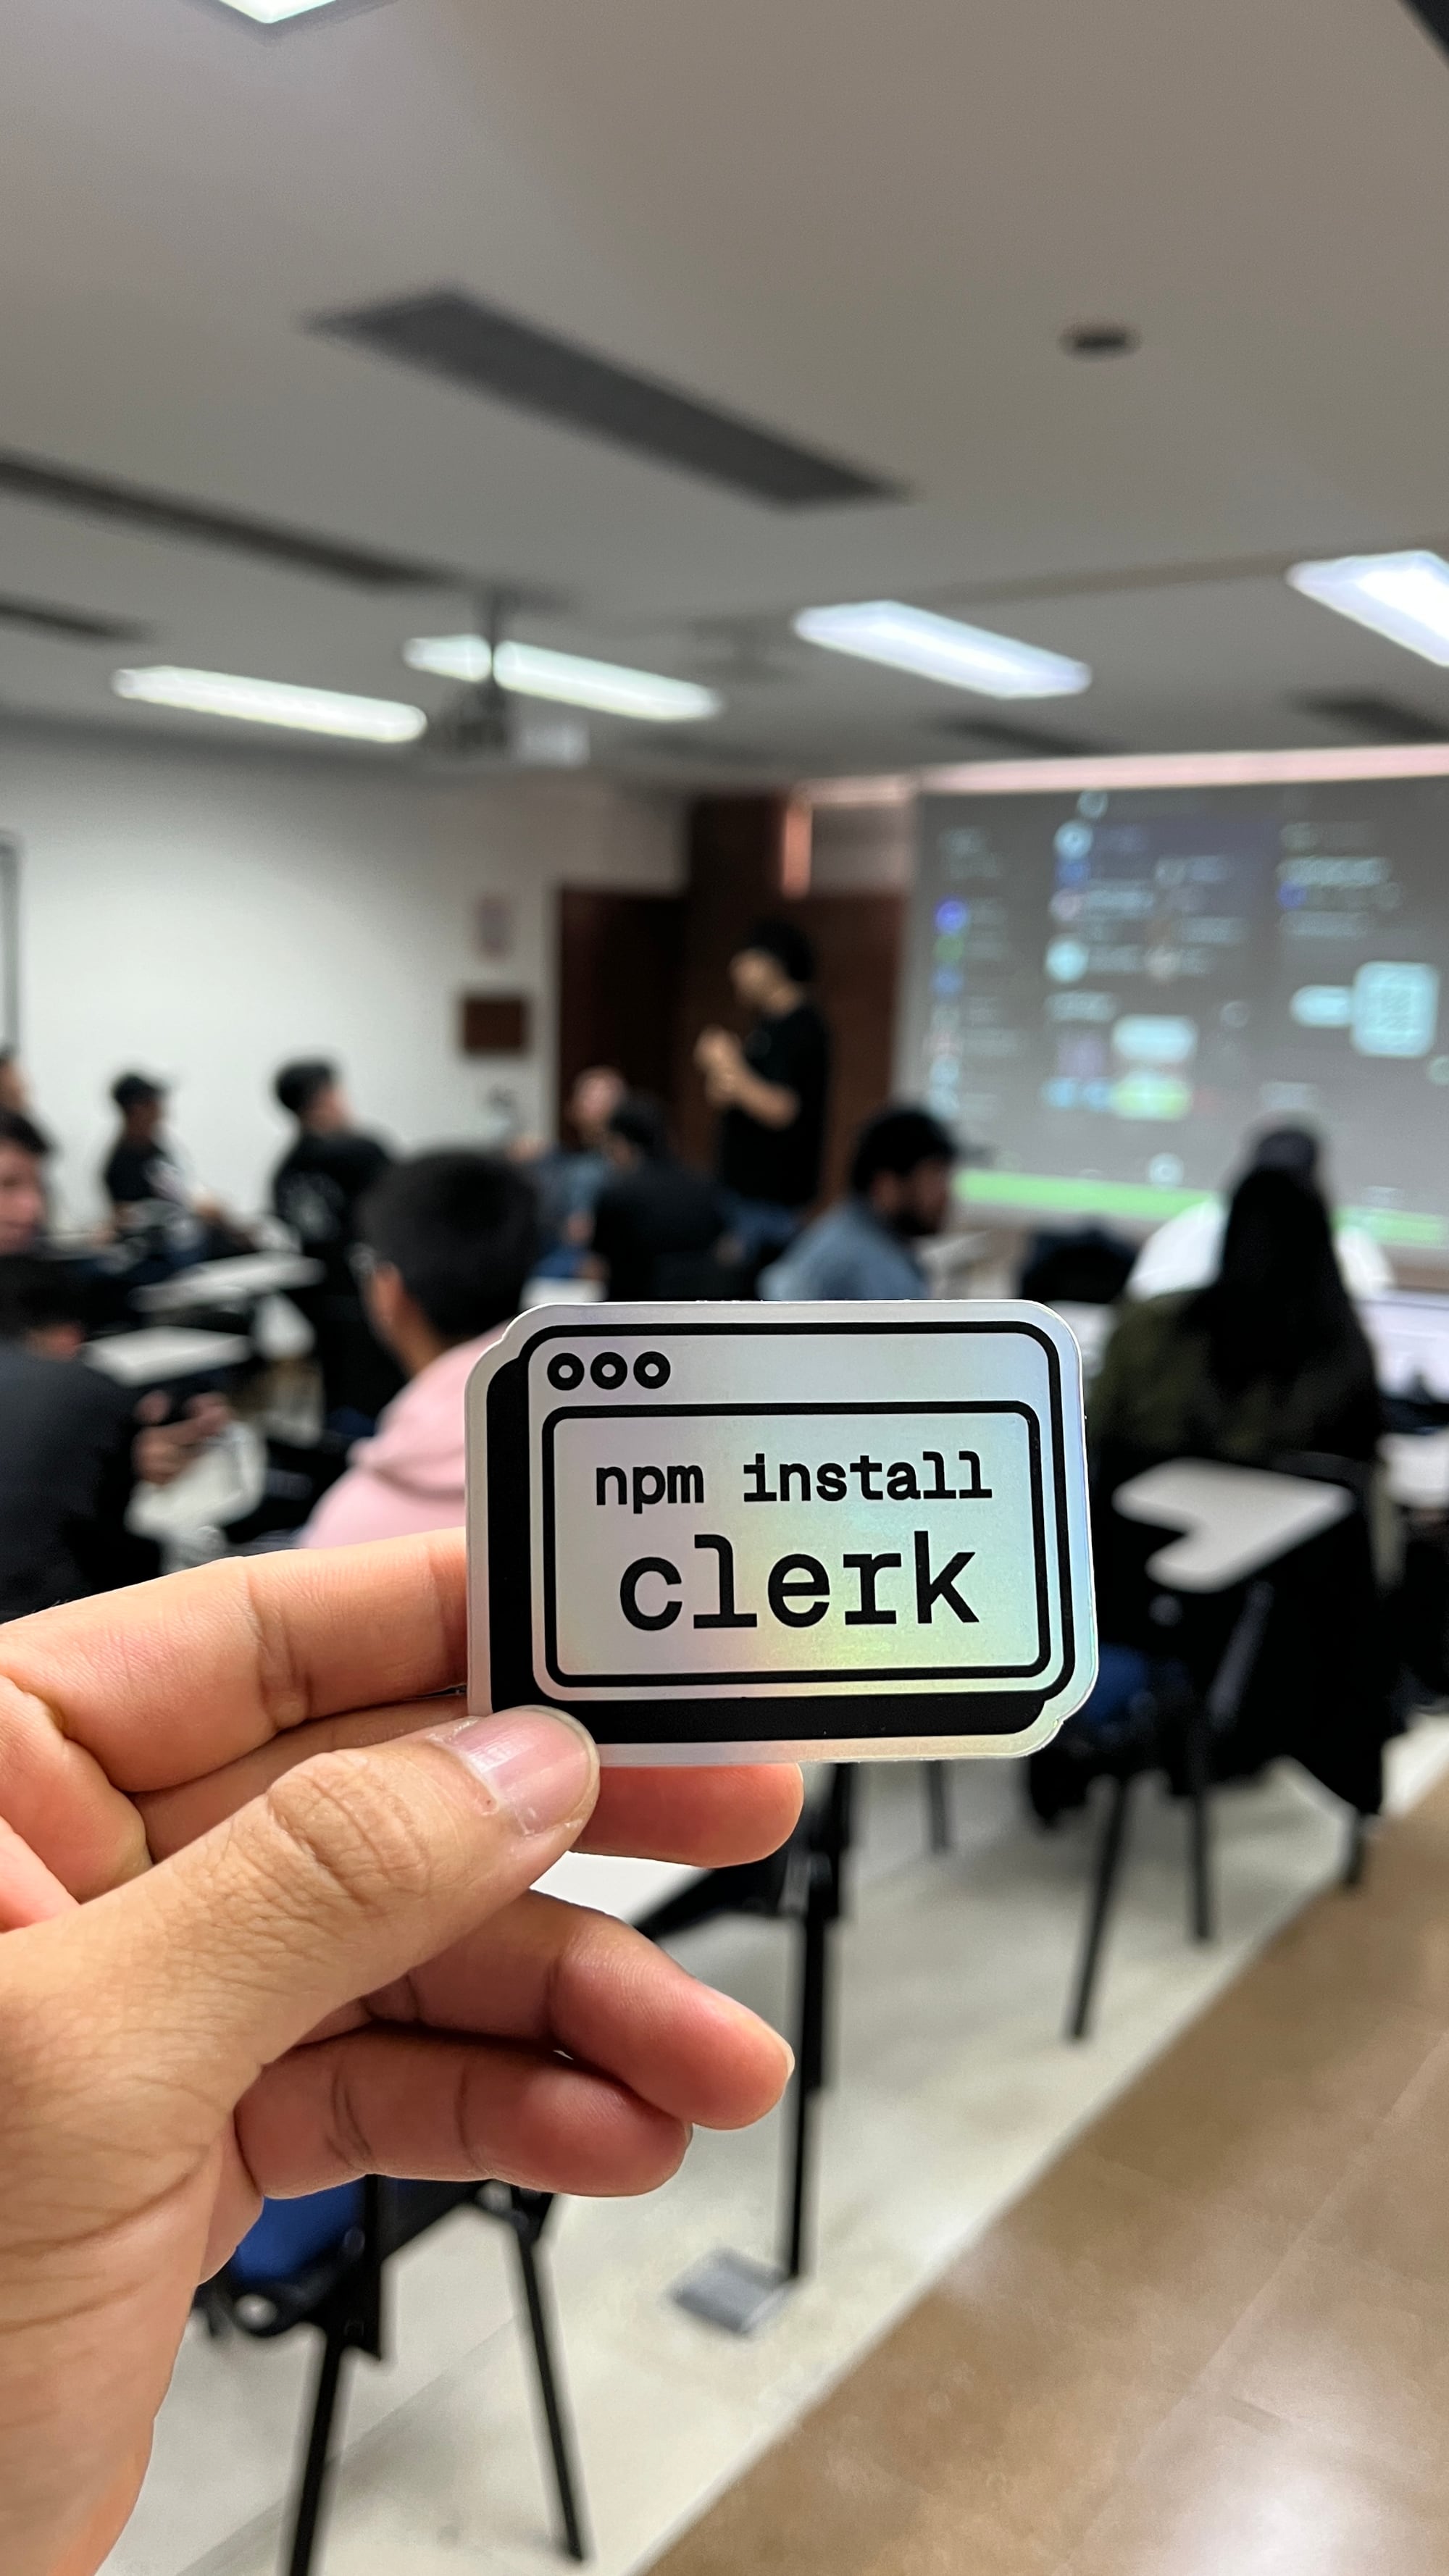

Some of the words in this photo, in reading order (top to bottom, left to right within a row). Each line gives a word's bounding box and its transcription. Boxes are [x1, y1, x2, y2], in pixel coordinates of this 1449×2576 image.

[596, 1465, 704, 1515] npm
[743, 1450, 993, 1502] install
[619, 1530, 980, 1631] clerk
